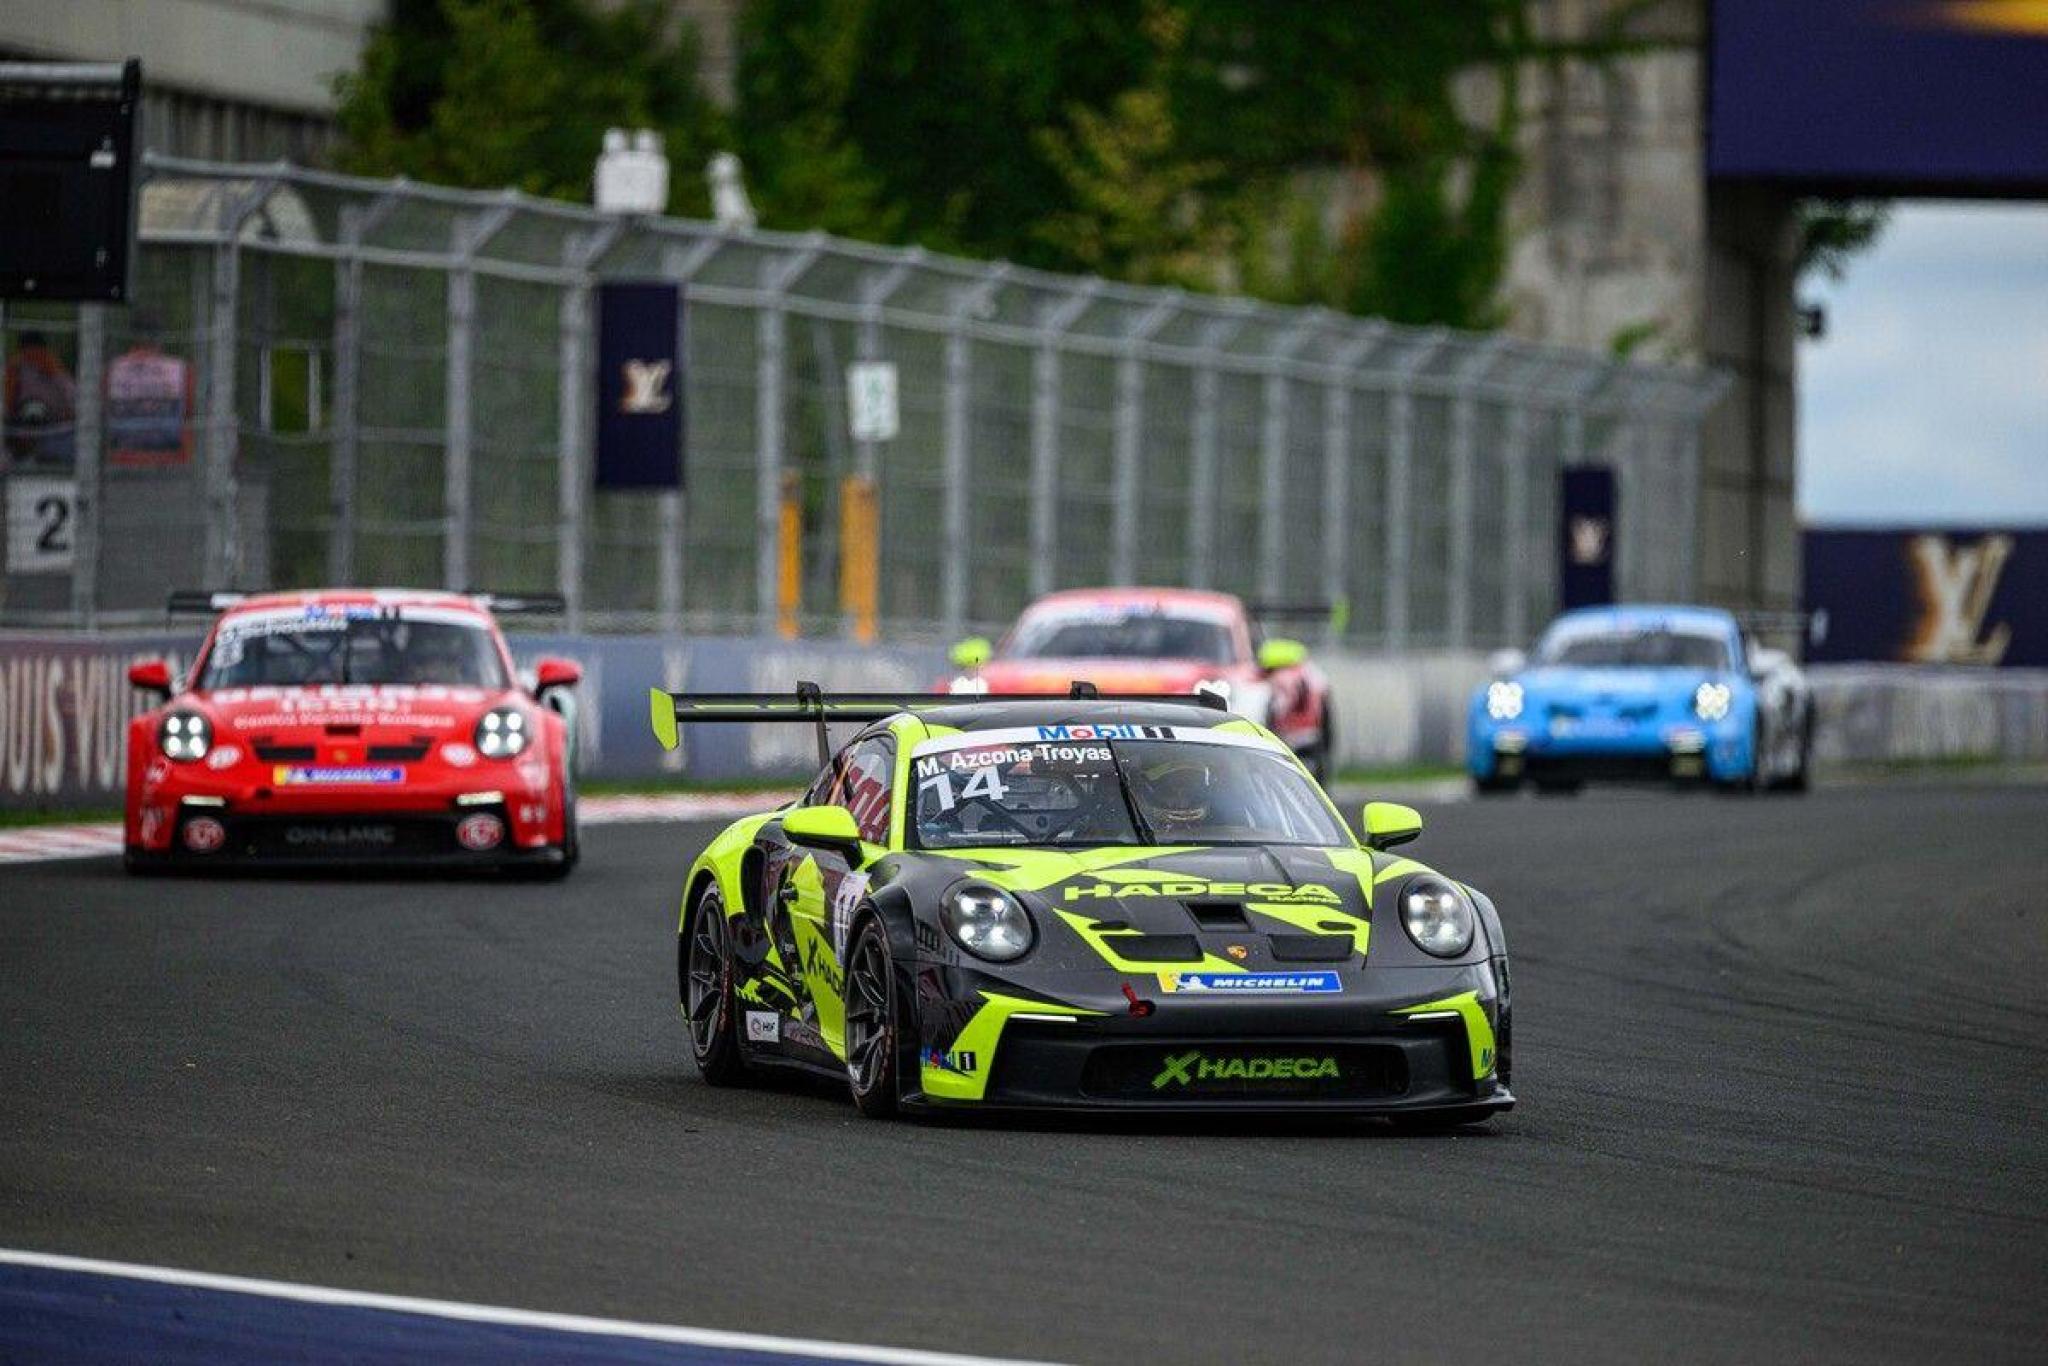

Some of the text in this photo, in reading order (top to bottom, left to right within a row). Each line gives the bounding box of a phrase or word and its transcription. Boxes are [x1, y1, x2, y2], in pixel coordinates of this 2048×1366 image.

[35, 498, 70, 552] 2
[1036, 723, 1137, 741] Mobil
[917, 744, 1112, 778] M. Azcona Troyas
[919, 765, 1010, 812] 14
[1064, 882, 1340, 901] HADECA
[1212, 977, 1325, 989] MICHELIN
[1197, 1057, 1341, 1080] HADECA
